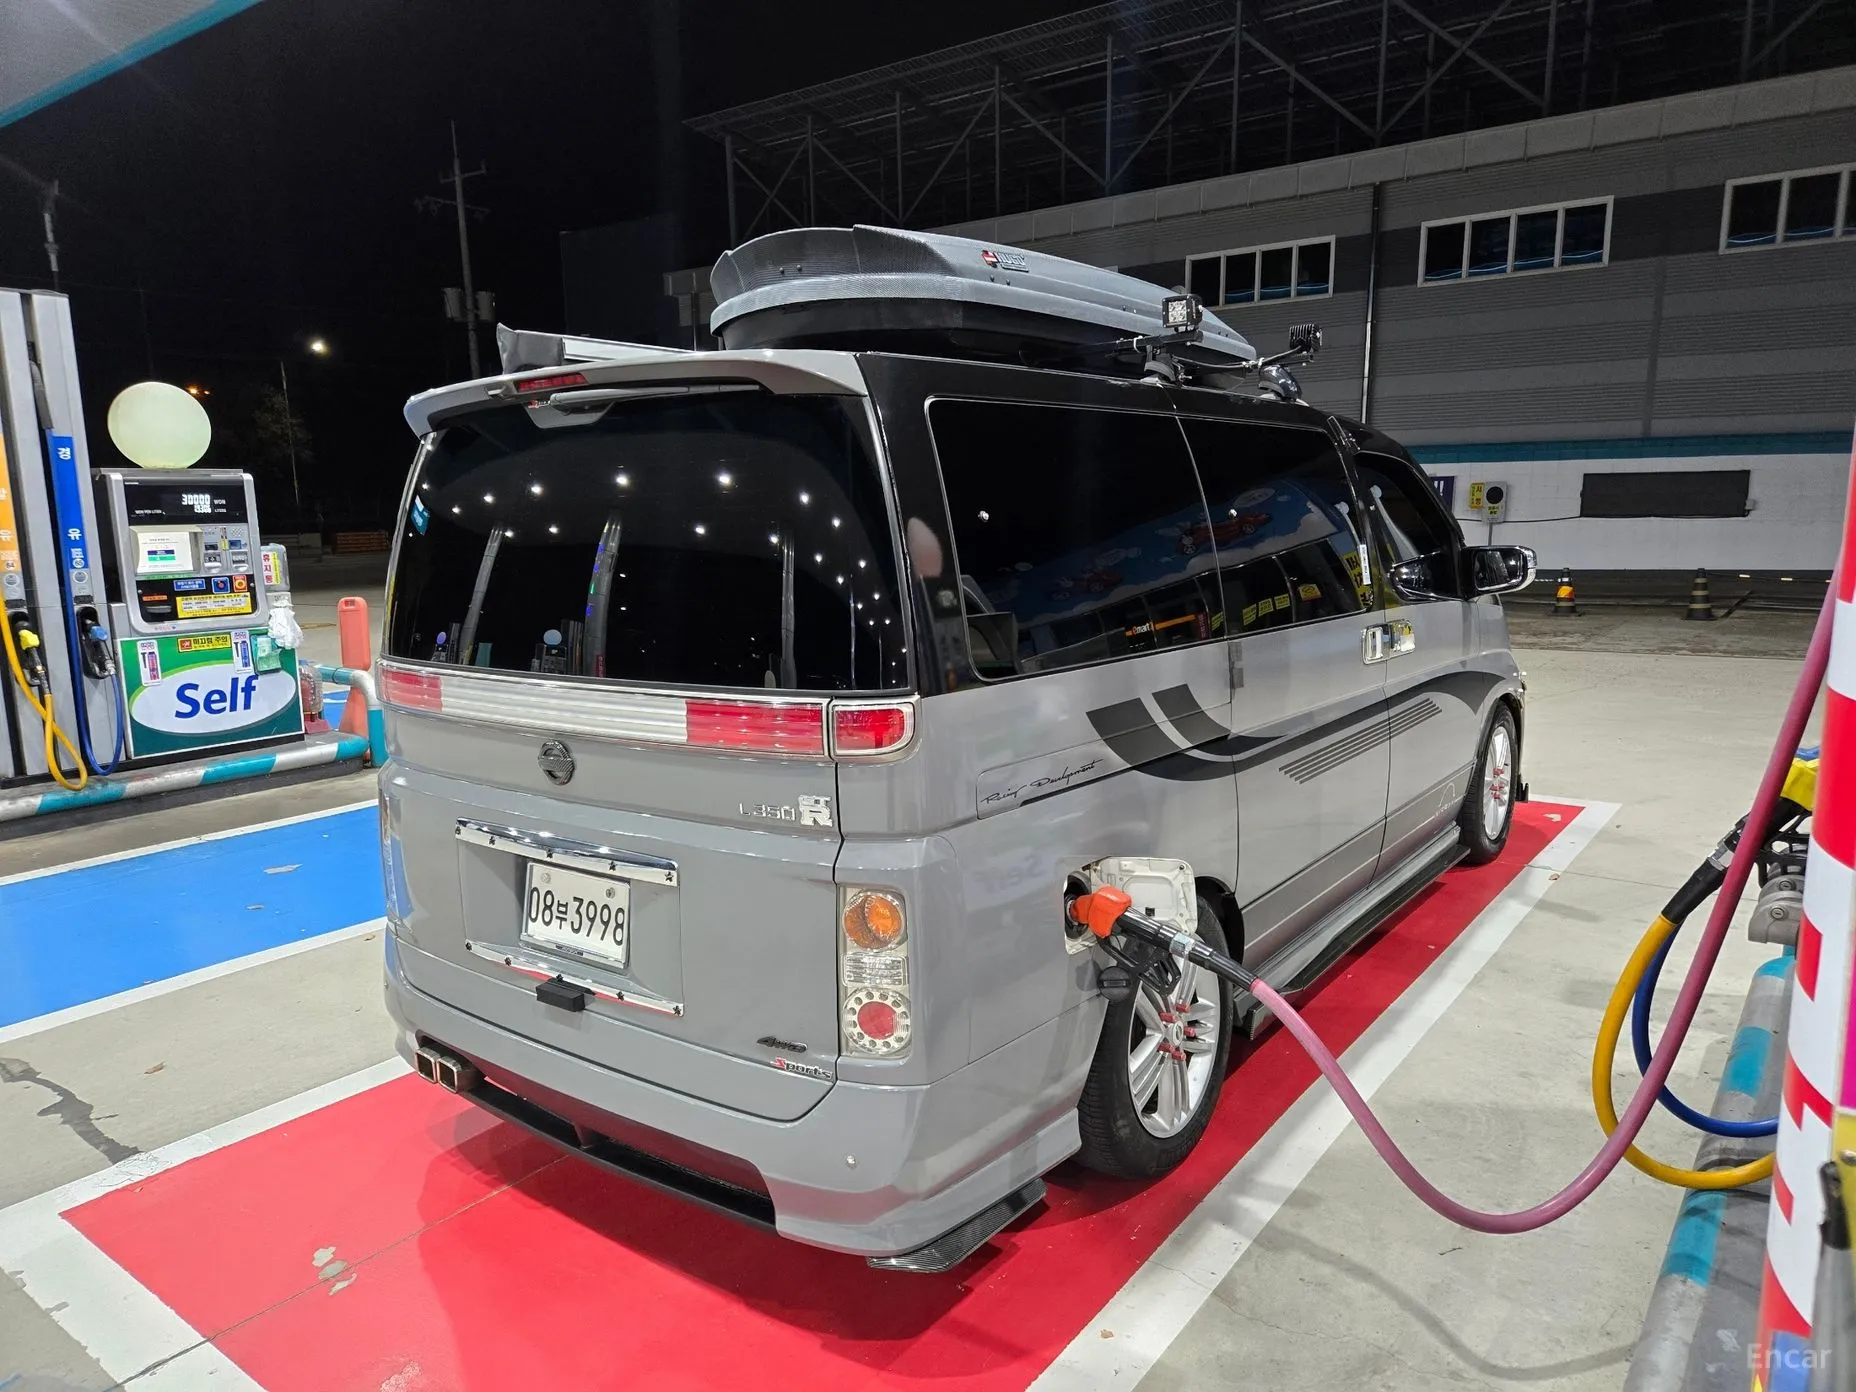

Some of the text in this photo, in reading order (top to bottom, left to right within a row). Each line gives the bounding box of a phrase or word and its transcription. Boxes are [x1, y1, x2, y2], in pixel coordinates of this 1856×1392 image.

[181, 493, 211, 506] 30000
[174, 674, 259, 719] Self
[528, 886, 625, 946] 08부3998
[769, 1056, 834, 1080] Sports
